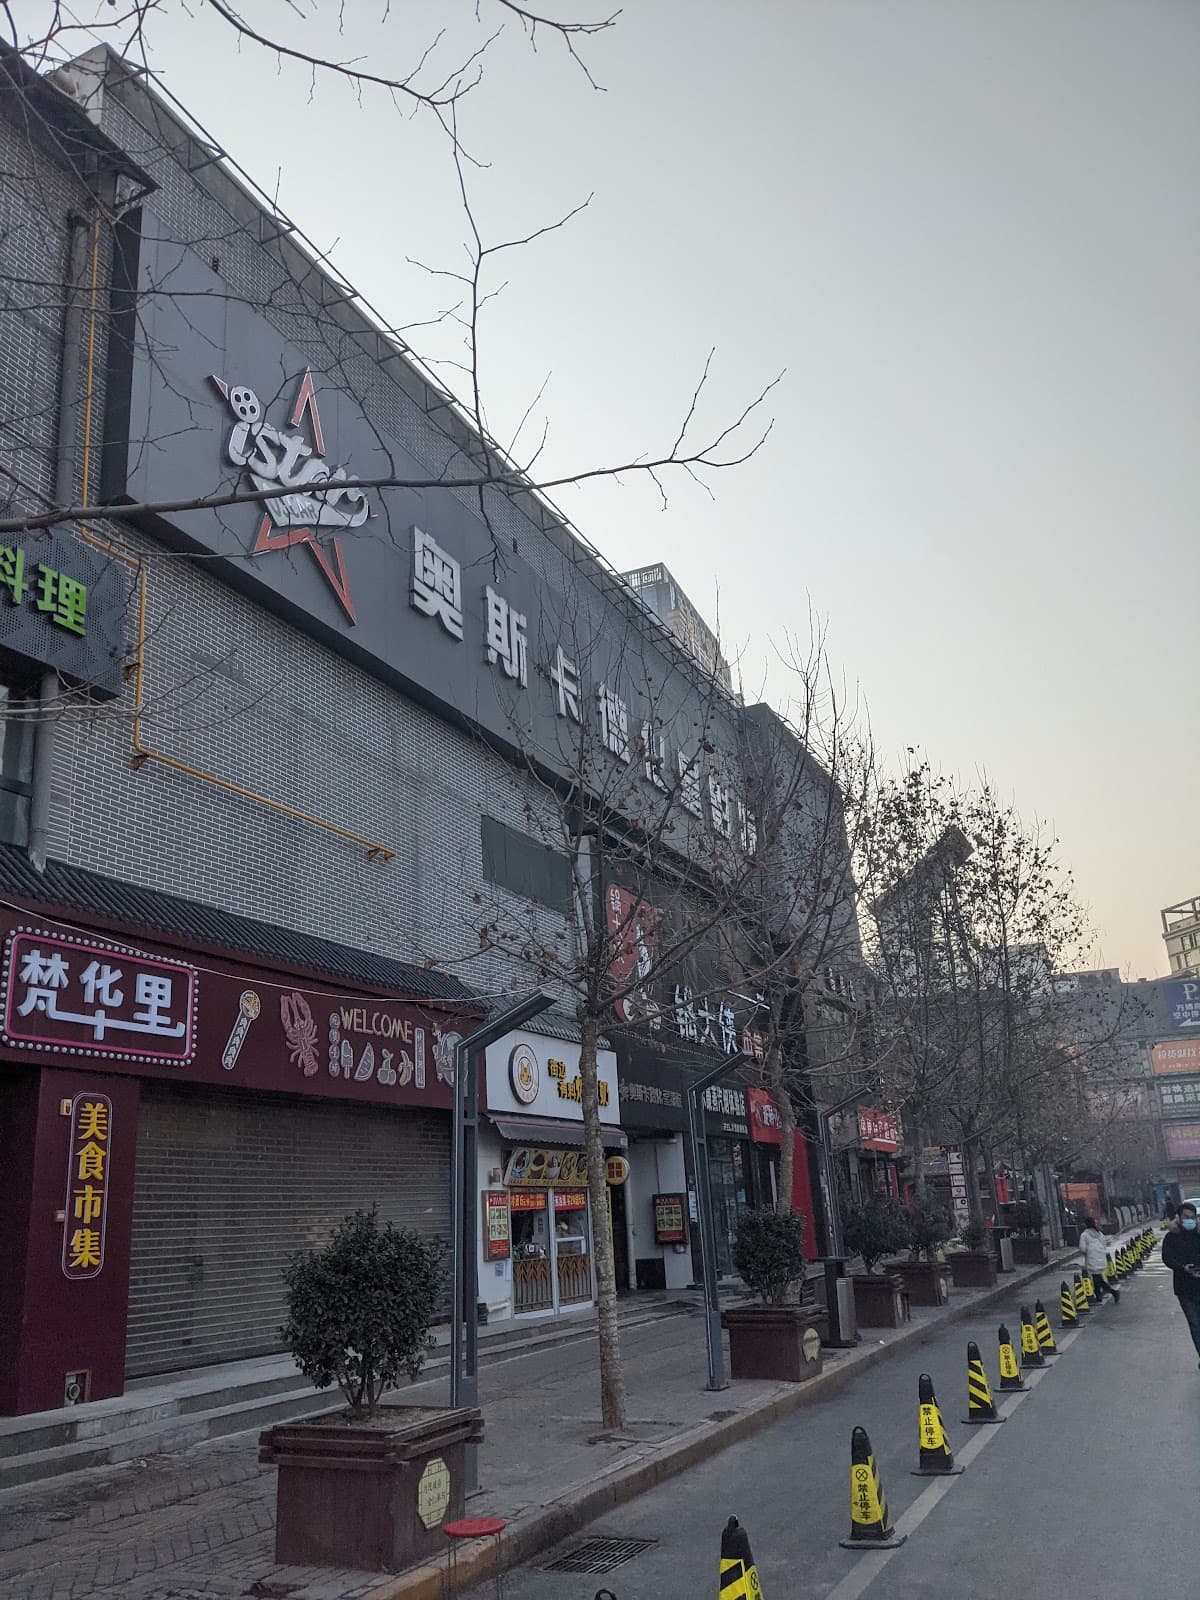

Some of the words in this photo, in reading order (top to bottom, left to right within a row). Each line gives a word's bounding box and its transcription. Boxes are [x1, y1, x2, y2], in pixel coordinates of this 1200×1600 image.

[340, 1006, 413, 1044] WELCOME
[69, 1102, 109, 1268] 美食市集
[923, 1406, 937, 1446] 禁止停车
[858, 1483, 872, 1521] 禁止停车
